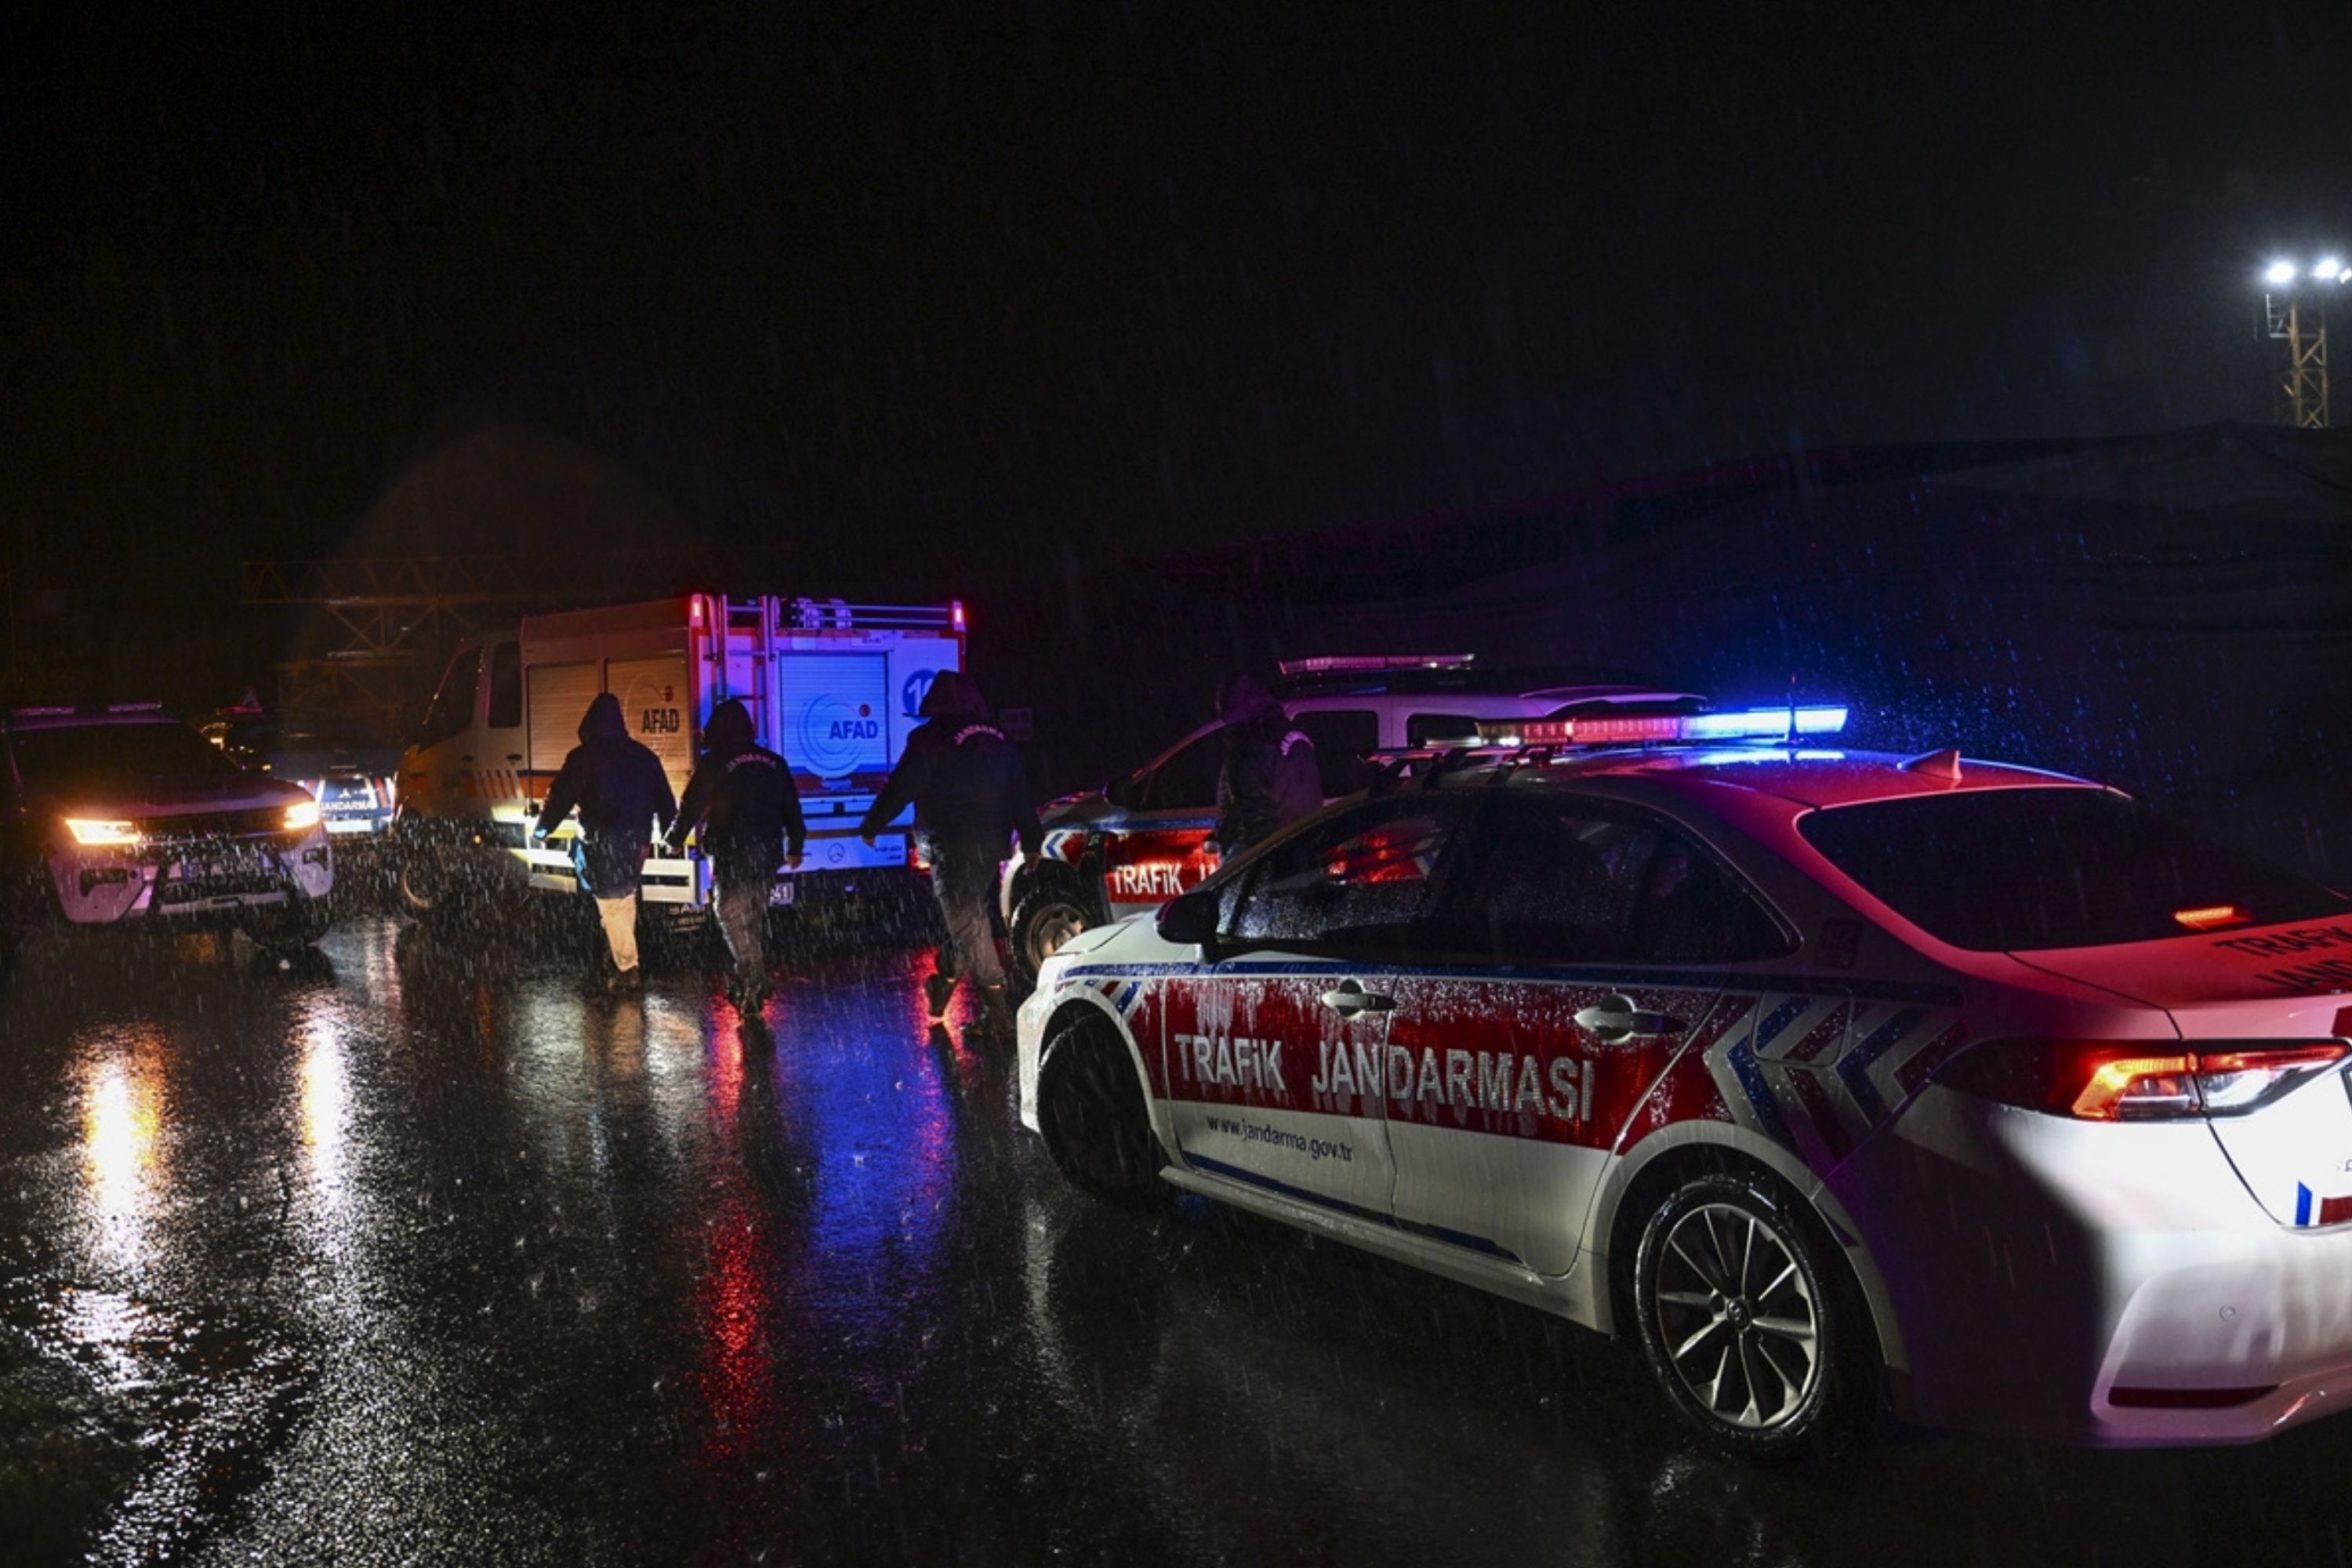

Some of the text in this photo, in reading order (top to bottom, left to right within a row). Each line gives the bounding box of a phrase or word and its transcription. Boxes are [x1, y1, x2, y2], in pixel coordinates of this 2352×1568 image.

[642, 708, 680, 733] AFAD
[829, 720, 878, 739] AFAD
[1311, 1040, 1593, 1122] JANDARMASI
[1207, 1115, 1353, 1162] www.jandarma.gov.tr
